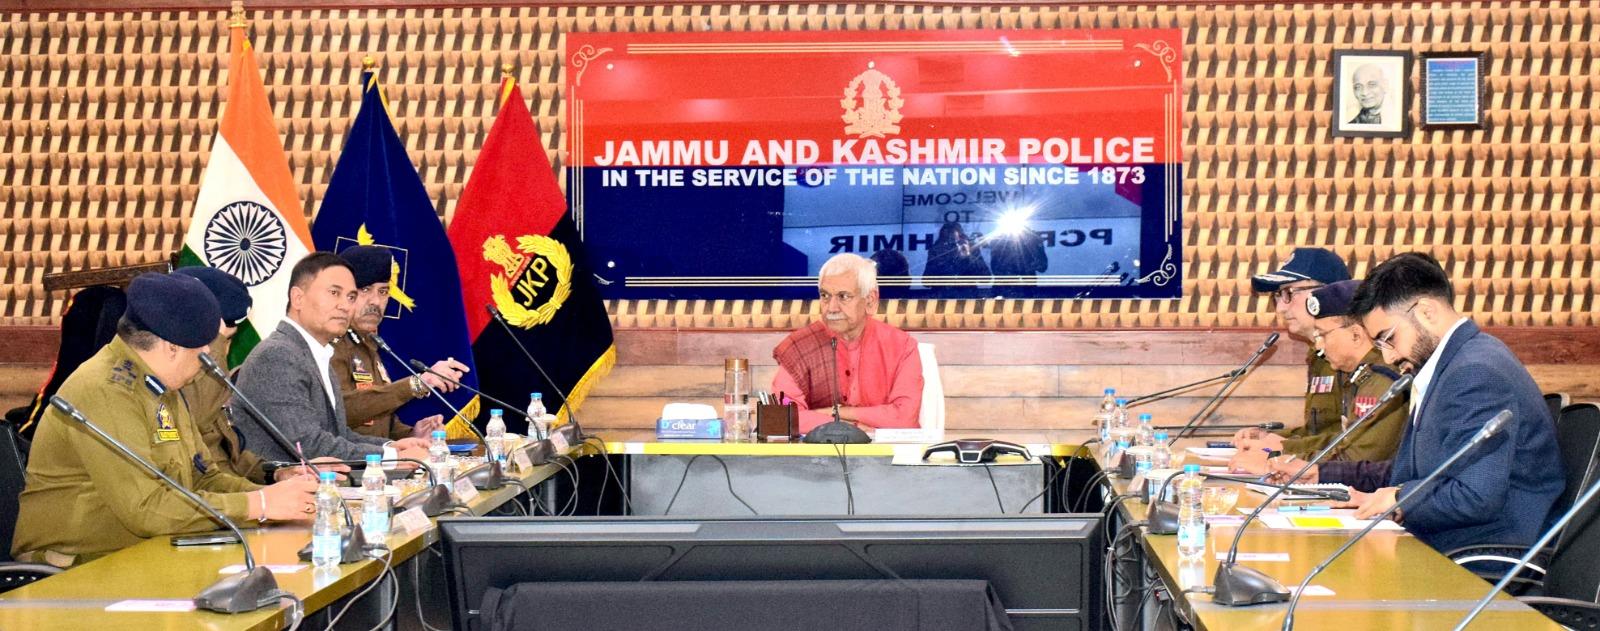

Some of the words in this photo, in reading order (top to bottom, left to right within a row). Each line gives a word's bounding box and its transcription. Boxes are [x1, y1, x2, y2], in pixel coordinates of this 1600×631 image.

[593, 139, 729, 167] JAMMU
[740, 139, 820, 165] AND
[832, 138, 1007, 165] KASHMIR
[1019, 137, 1155, 164] POLICE
[602, 169, 628, 187] IN
[635, 169, 684, 187] THE
[691, 168, 798, 187] SERVICE
[805, 168, 838, 187] OF
[844, 168, 895, 186] THE
[902, 167, 993, 186] NATION
[1003, 167, 1079, 185] SINCE
[1087, 166, 1146, 185] 1873
[516, 257, 550, 307] JKP
